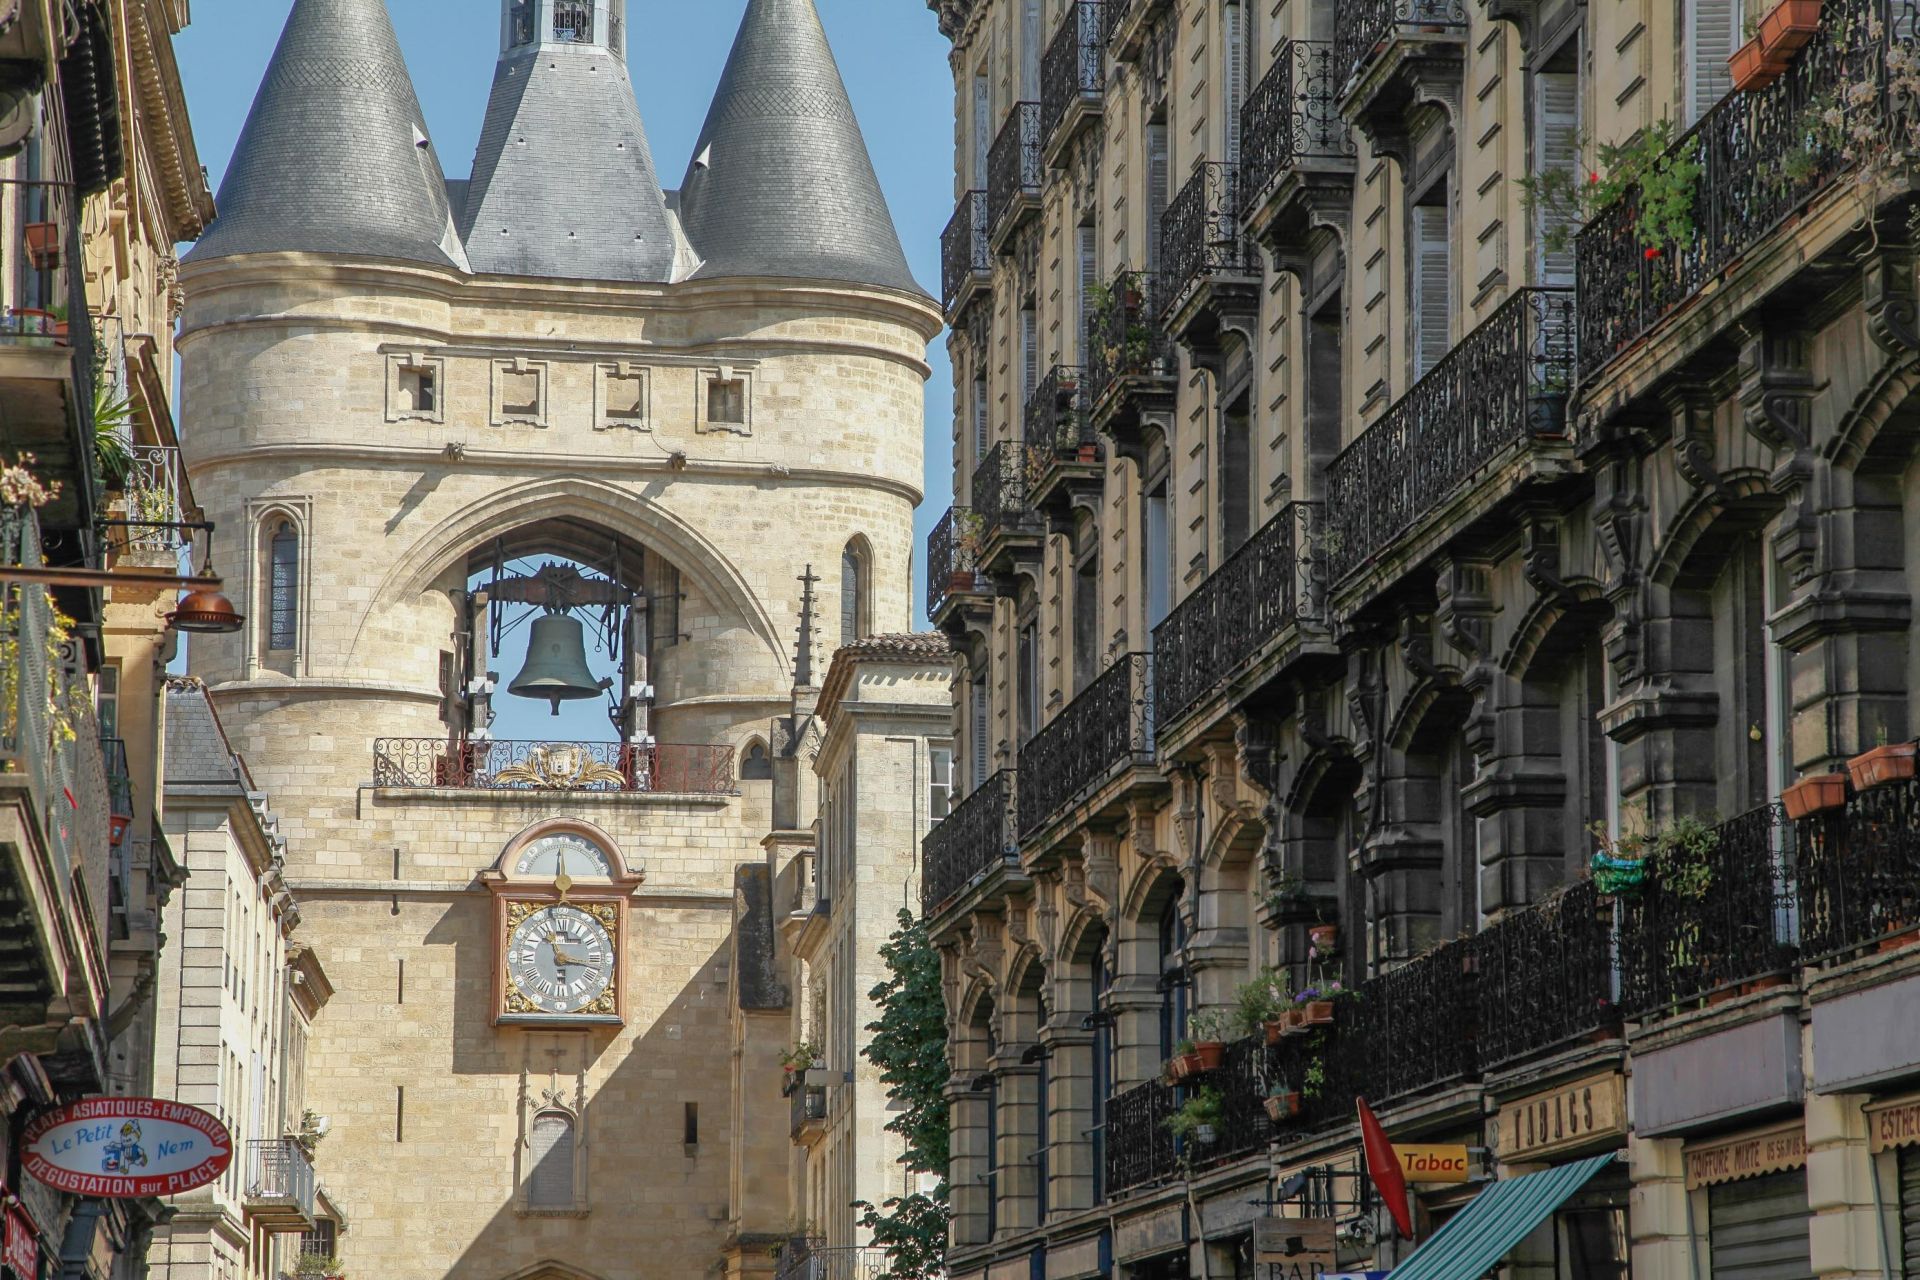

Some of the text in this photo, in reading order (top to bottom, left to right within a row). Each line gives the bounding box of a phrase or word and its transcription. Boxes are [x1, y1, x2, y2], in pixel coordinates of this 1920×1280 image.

[24, 1108, 65, 1141] PLATS
[73, 1100, 153, 1119] ASIATIQUES
[161, 1103, 229, 1145] EMPORTER
[1513, 1087, 1593, 1150] TABACS
[51, 1124, 193, 1160] Le Petit Nem
[1692, 1147, 1729, 1179] COIFFURE
[1735, 1141, 1760, 1171] MIXTE
[27, 1157, 219, 1193] DEGUSTATION sur PLACE
[1403, 1152, 1465, 1171] Tabac
